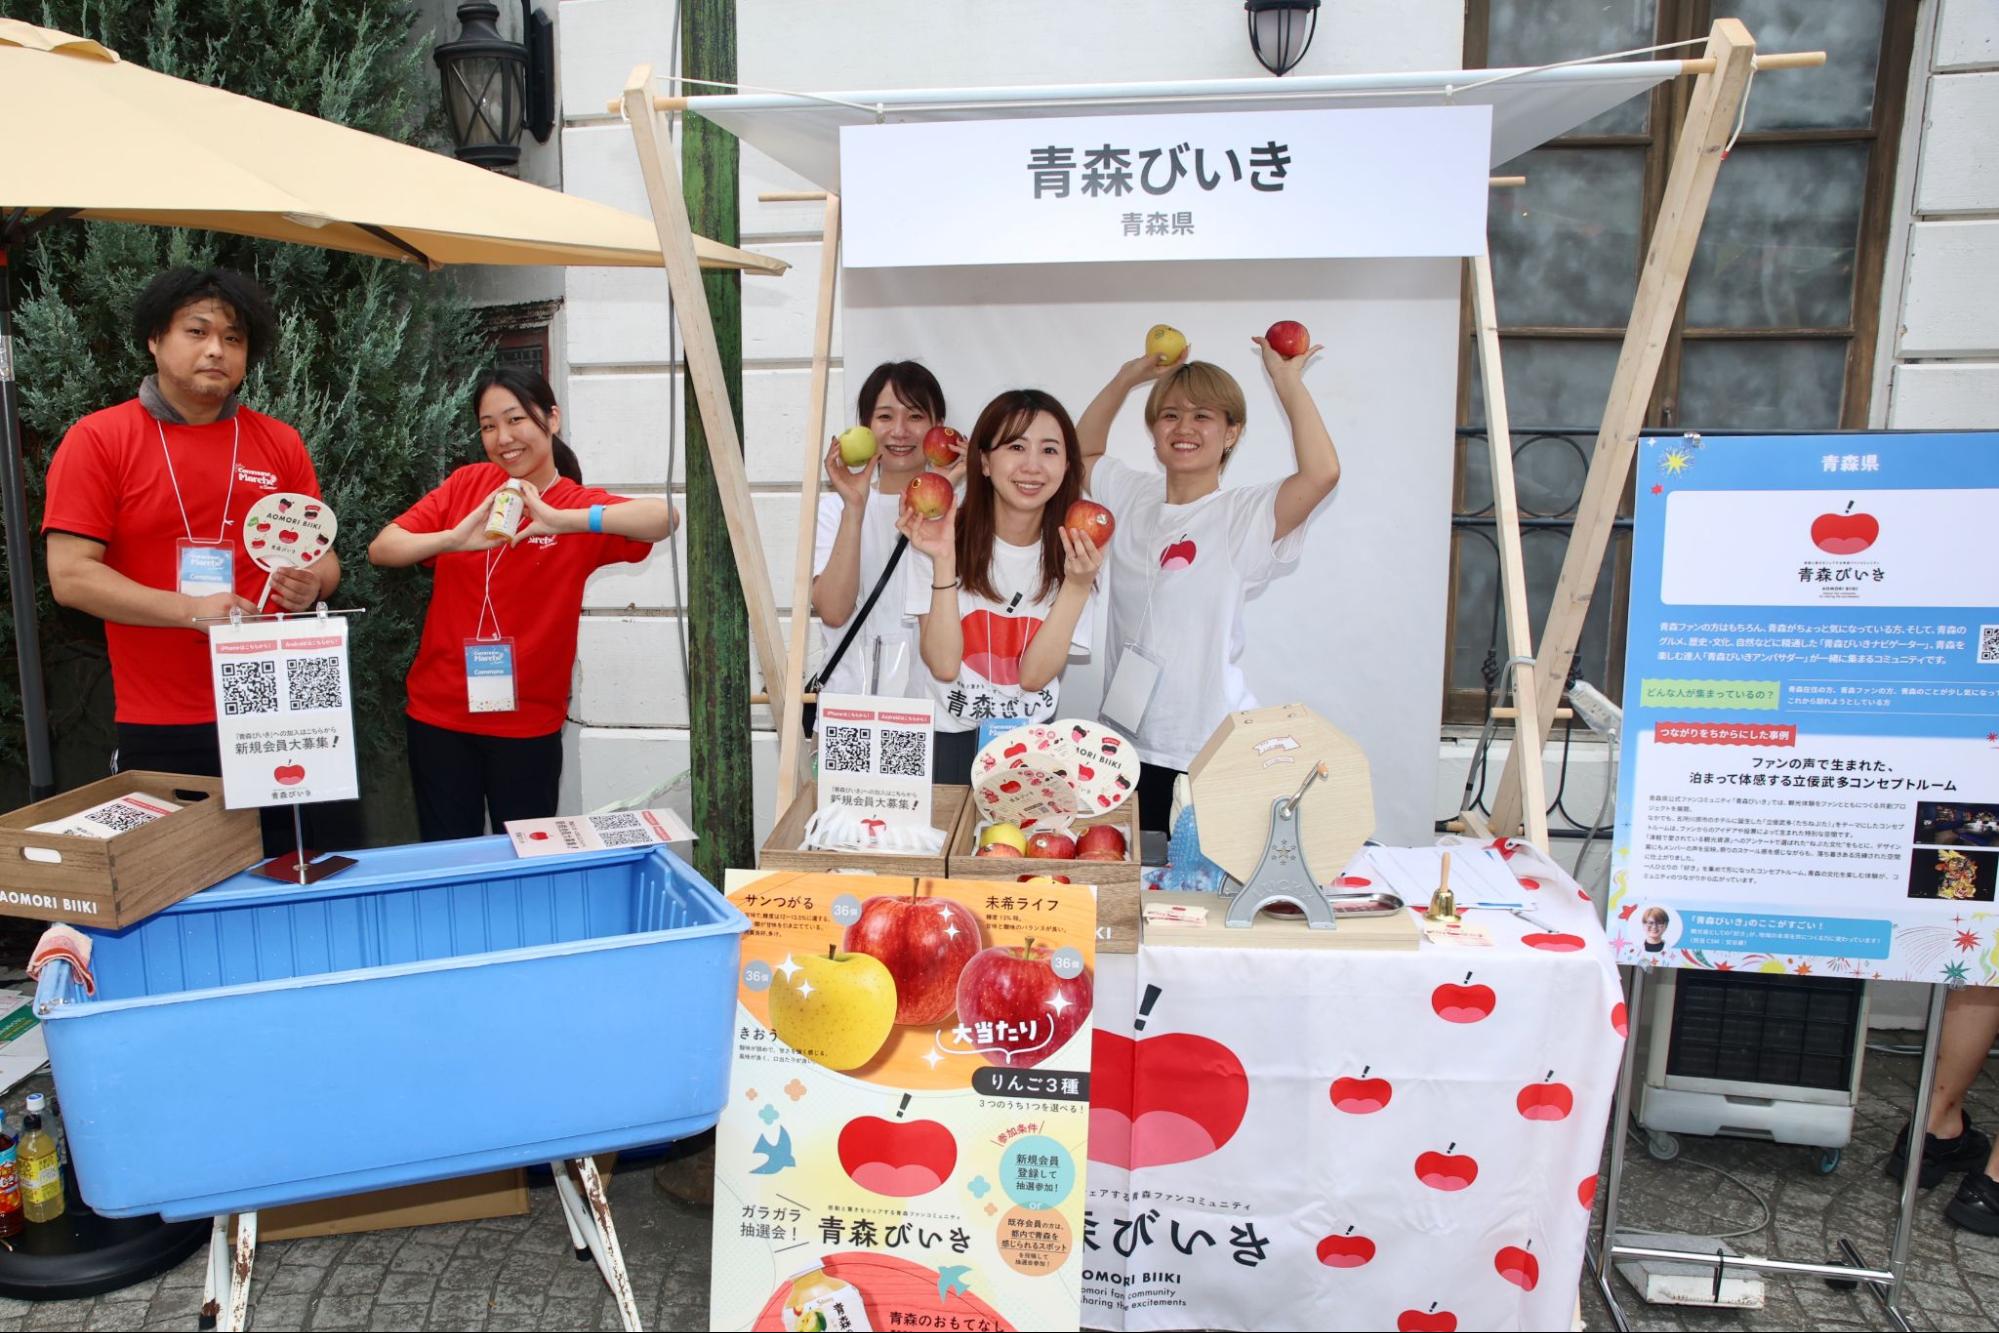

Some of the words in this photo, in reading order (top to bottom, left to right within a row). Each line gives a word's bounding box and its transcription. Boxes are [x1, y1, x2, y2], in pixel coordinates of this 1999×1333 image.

[1027, 141, 1292, 199] 青森びいき
[1121, 211, 1195, 237] 青森県
[1821, 453, 1880, 472] 青森県
[266, 513, 300, 525] AOMORI
[303, 520, 322, 530] BIIKI
[1798, 566, 1885, 582] 青森びいき
[947, 689, 1053, 720] 青森びいき
[1660, 728, 1790, 741] つながりをちからにした事例
[1099, 755, 1122, 769] BIIKI
[1752, 757, 1895, 772] ファンの声で生まれた、
[1689, 772, 1958, 791] 泊まって体感する立佞武多コンセプトルーム
[0, 890, 57, 909] AOMORI
[63, 898, 97, 914] BIIKI
[745, 894, 814, 910] サンつがる
[985, 895, 1059, 911] 未希ライフ
[739, 1026, 778, 1041] きおう
[952, 1020, 1037, 1044] 大当たり
[991, 1073, 1080, 1095] りんご3種
[997, 1122, 1039, 1144] 参加条件
[1016, 1154, 1059, 1167] 新規会員
[1017, 1167, 1058, 1179] 登録して
[741, 1204, 801, 1222] ガラガラ
[1029, 1202, 1042, 1210] or
[740, 1222, 798, 1241] 抽選会！
[818, 1215, 971, 1254] 青森びいき
[1011, 1230, 1059, 1240] 都内で青森を
[1001, 1240, 1067, 1251] 感じられるスポット
[1142, 1272, 1181, 1284] BIIKI
[1111, 1288, 1126, 1300] fan
[1128, 1288, 1176, 1299] community
[1117, 1301, 1129, 1311] the
[1131, 1300, 1187, 1309] excitements
[889, 1311, 1005, 1332] 青森のおもてなし
